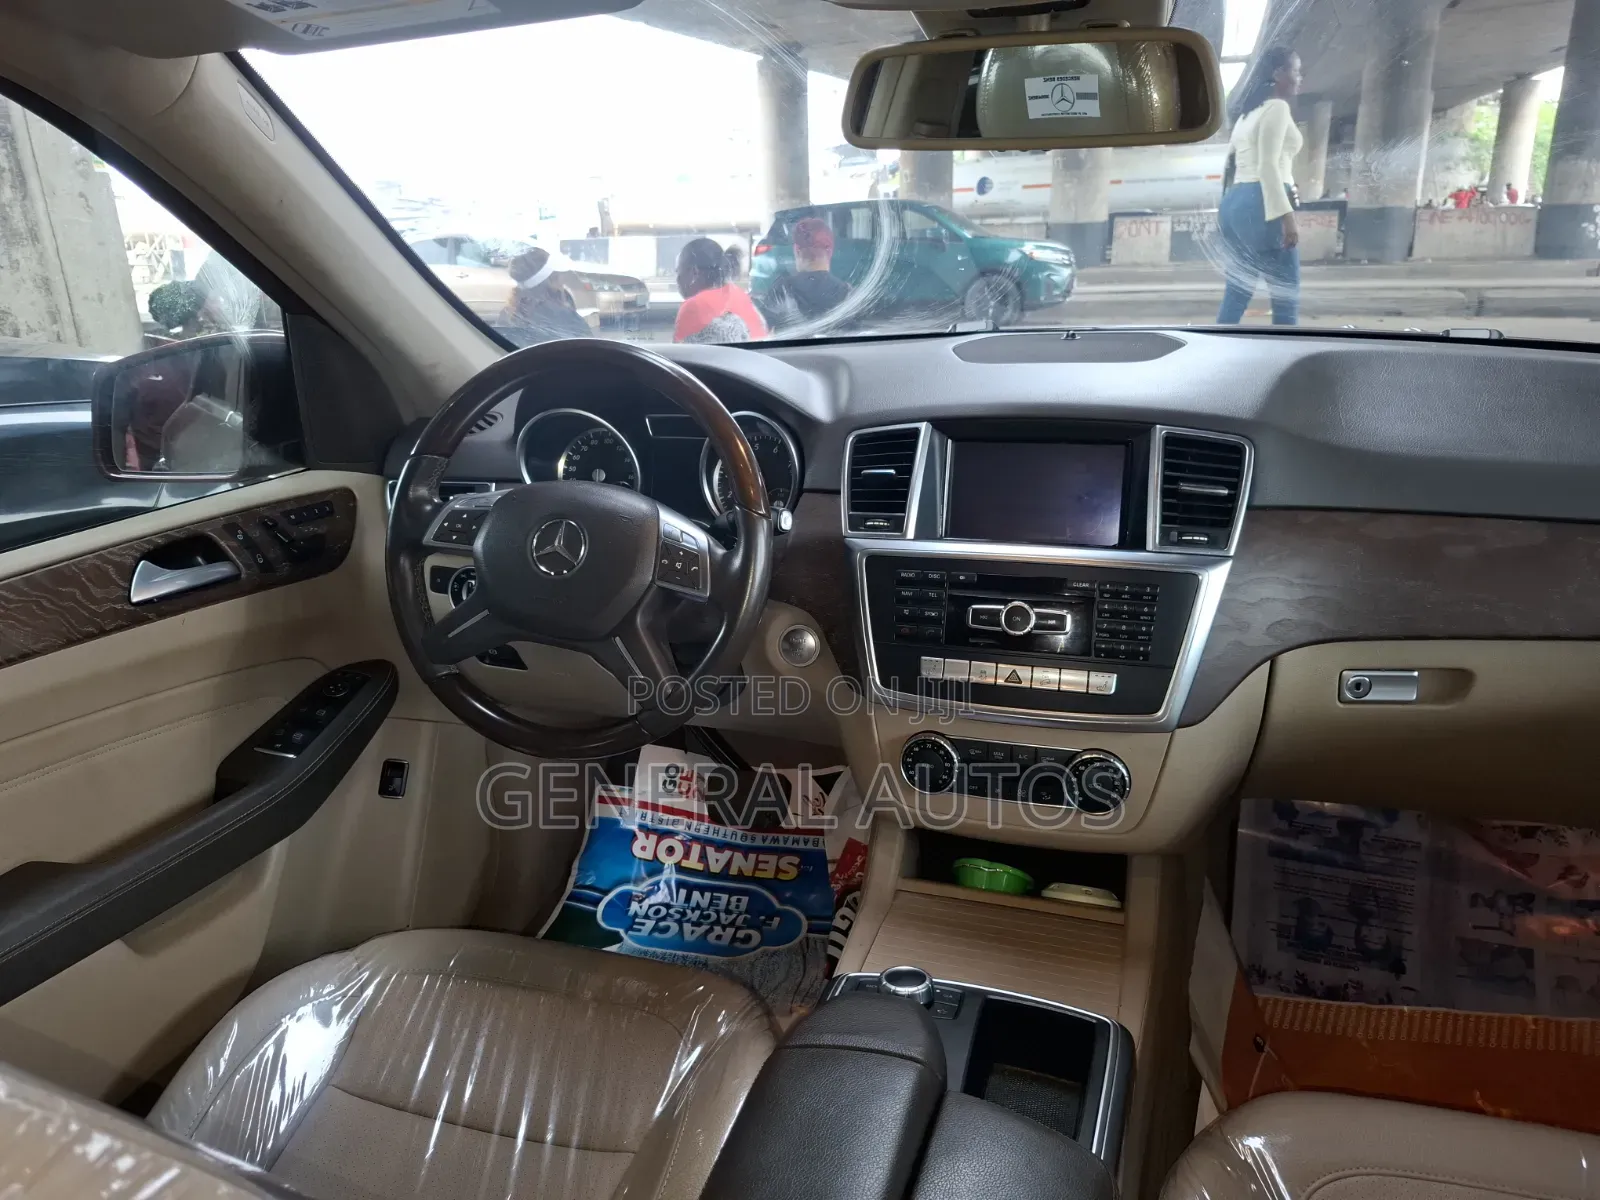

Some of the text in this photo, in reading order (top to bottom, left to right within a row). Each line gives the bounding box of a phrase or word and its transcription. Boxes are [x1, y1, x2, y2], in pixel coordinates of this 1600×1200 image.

[618, 807, 681, 828] DISTRT
[684, 821, 757, 844] SOUTHERN
[631, 829, 801, 881] SENATOR
[628, 899, 782, 931] F. JACKSON
[677, 887, 750, 915] BENT
[628, 918, 763, 950] GRACE
